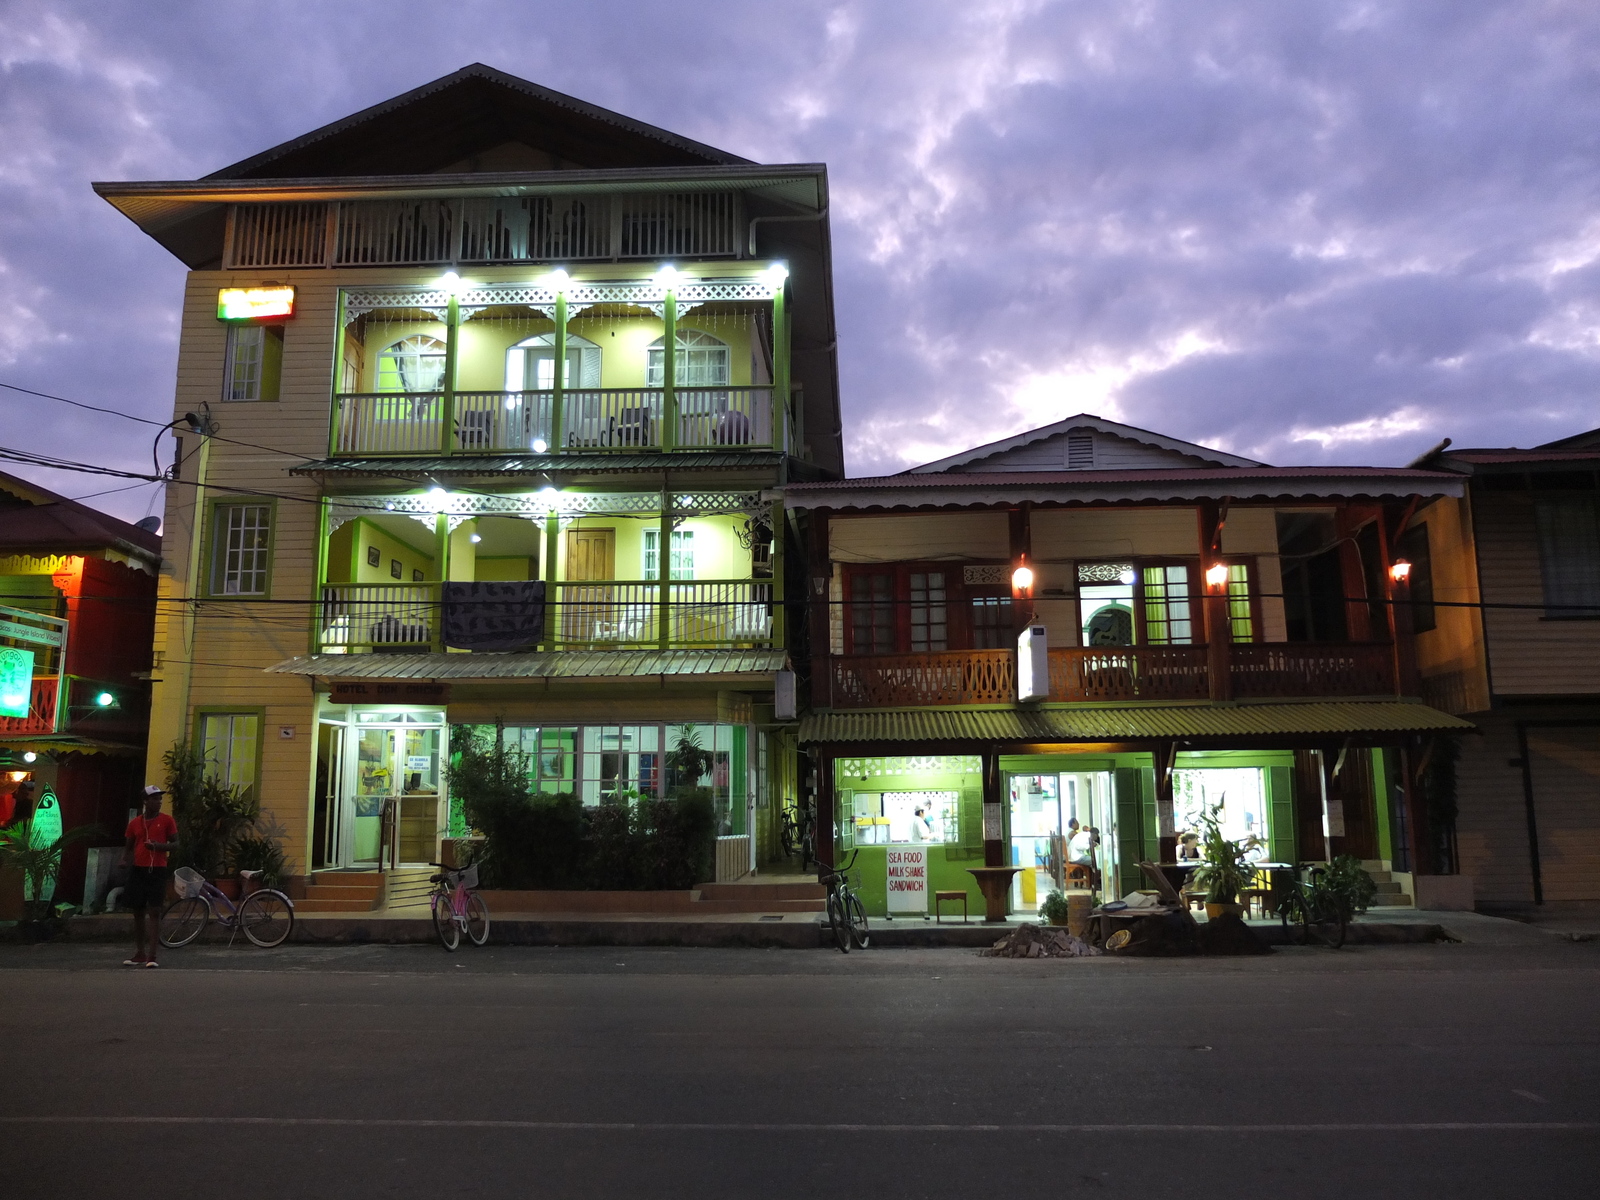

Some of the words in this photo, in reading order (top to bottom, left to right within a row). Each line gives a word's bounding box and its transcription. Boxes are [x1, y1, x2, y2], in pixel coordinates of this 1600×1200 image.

[14, 627, 29, 637] Jungle
[31, 630, 45, 639] Island
[336, 685, 369, 694] HOTEL
[377, 685, 398, 694] DON
[888, 852, 902, 863] SEA
[903, 852, 922, 863] FOOD
[888, 866, 904, 877] MILK
[904, 866, 925, 877] SHAKE
[889, 880, 924, 891] SANDWICH
